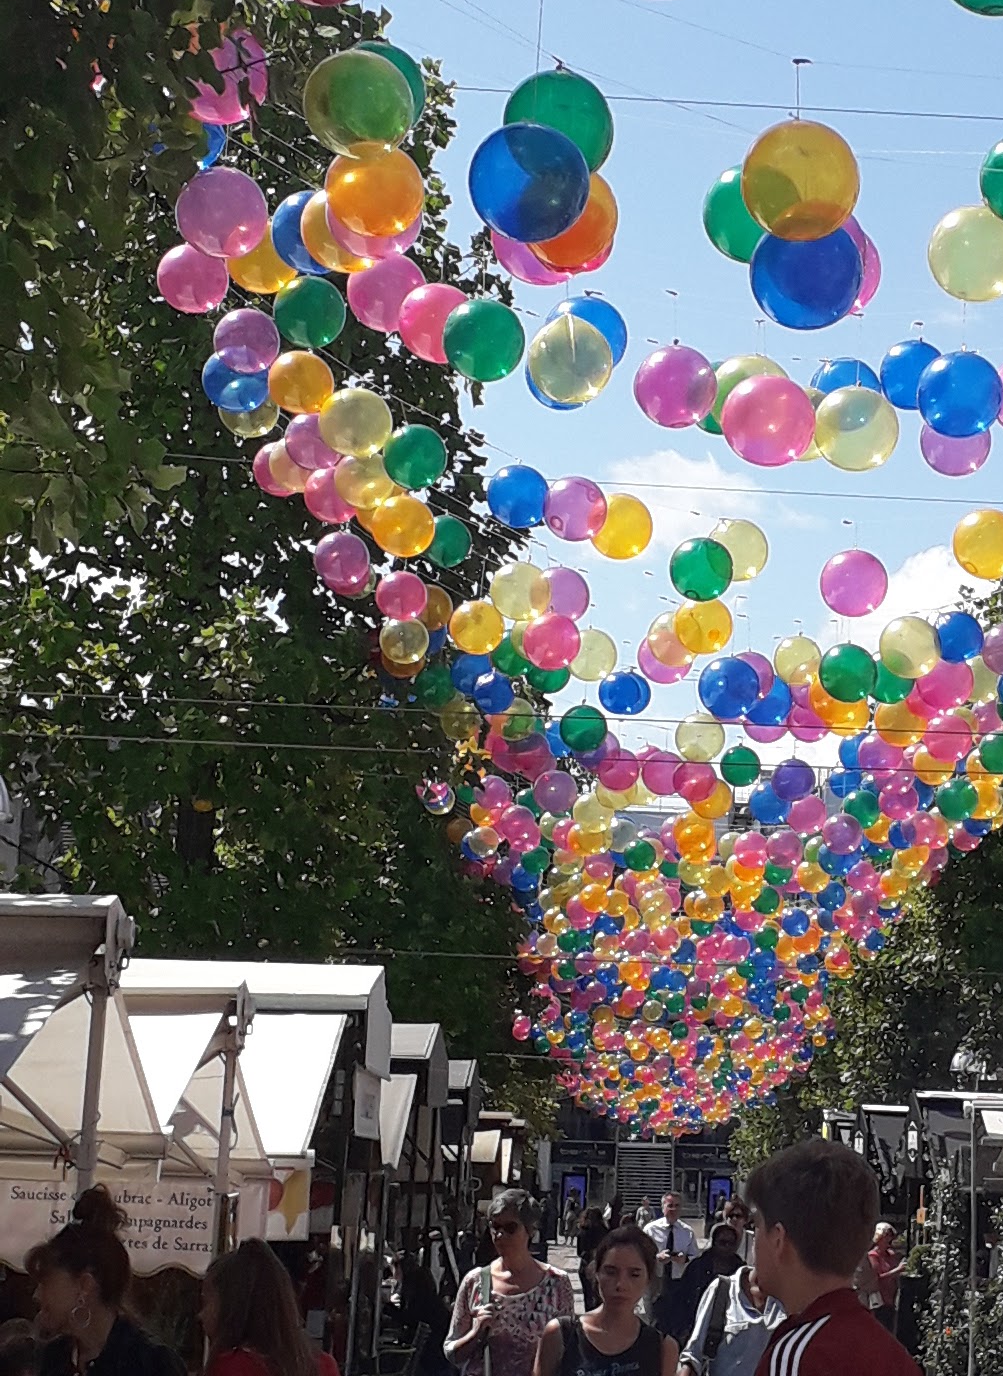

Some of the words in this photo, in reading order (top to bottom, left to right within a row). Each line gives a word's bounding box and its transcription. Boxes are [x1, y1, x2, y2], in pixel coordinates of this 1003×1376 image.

[10, 1185, 67, 1201] Saucisse
[113, 1189, 152, 1205] ubrac
[167, 1191, 213, 1212] Aligot
[152, 1235, 169, 1250] de
